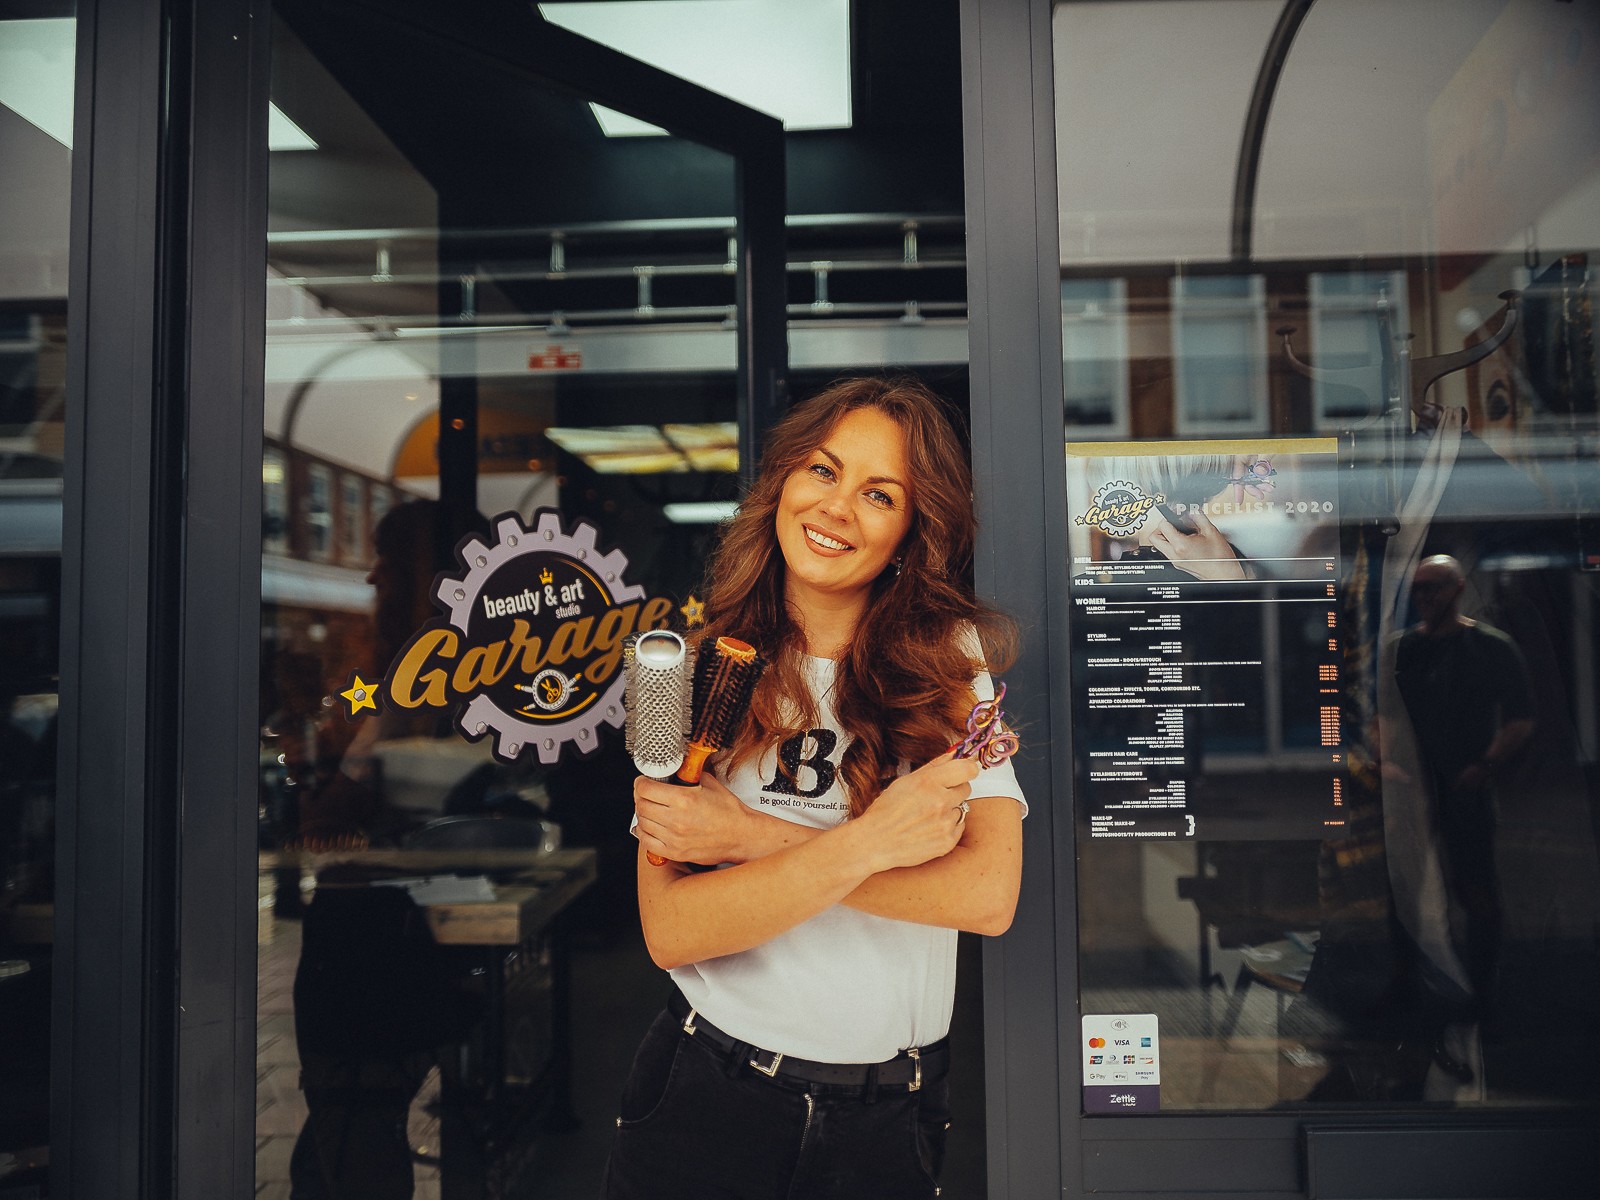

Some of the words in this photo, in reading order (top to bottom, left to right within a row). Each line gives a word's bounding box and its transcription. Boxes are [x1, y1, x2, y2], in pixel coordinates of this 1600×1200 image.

[1085, 497, 1153, 524] Garage
[1176, 502, 1275, 515] PRICELIST
[1285, 500, 1334, 514] 2020
[483, 589, 540, 619] beauty
[544, 585, 558, 606] &
[560, 578, 585, 603] art
[555, 603, 581, 619] studio
[390, 597, 672, 708] Garage
[760, 797, 769, 805] Be
[771, 798, 791, 806] good
[803, 801, 838, 810] yourself,
[1110, 1094, 1136, 1103] Zettle
